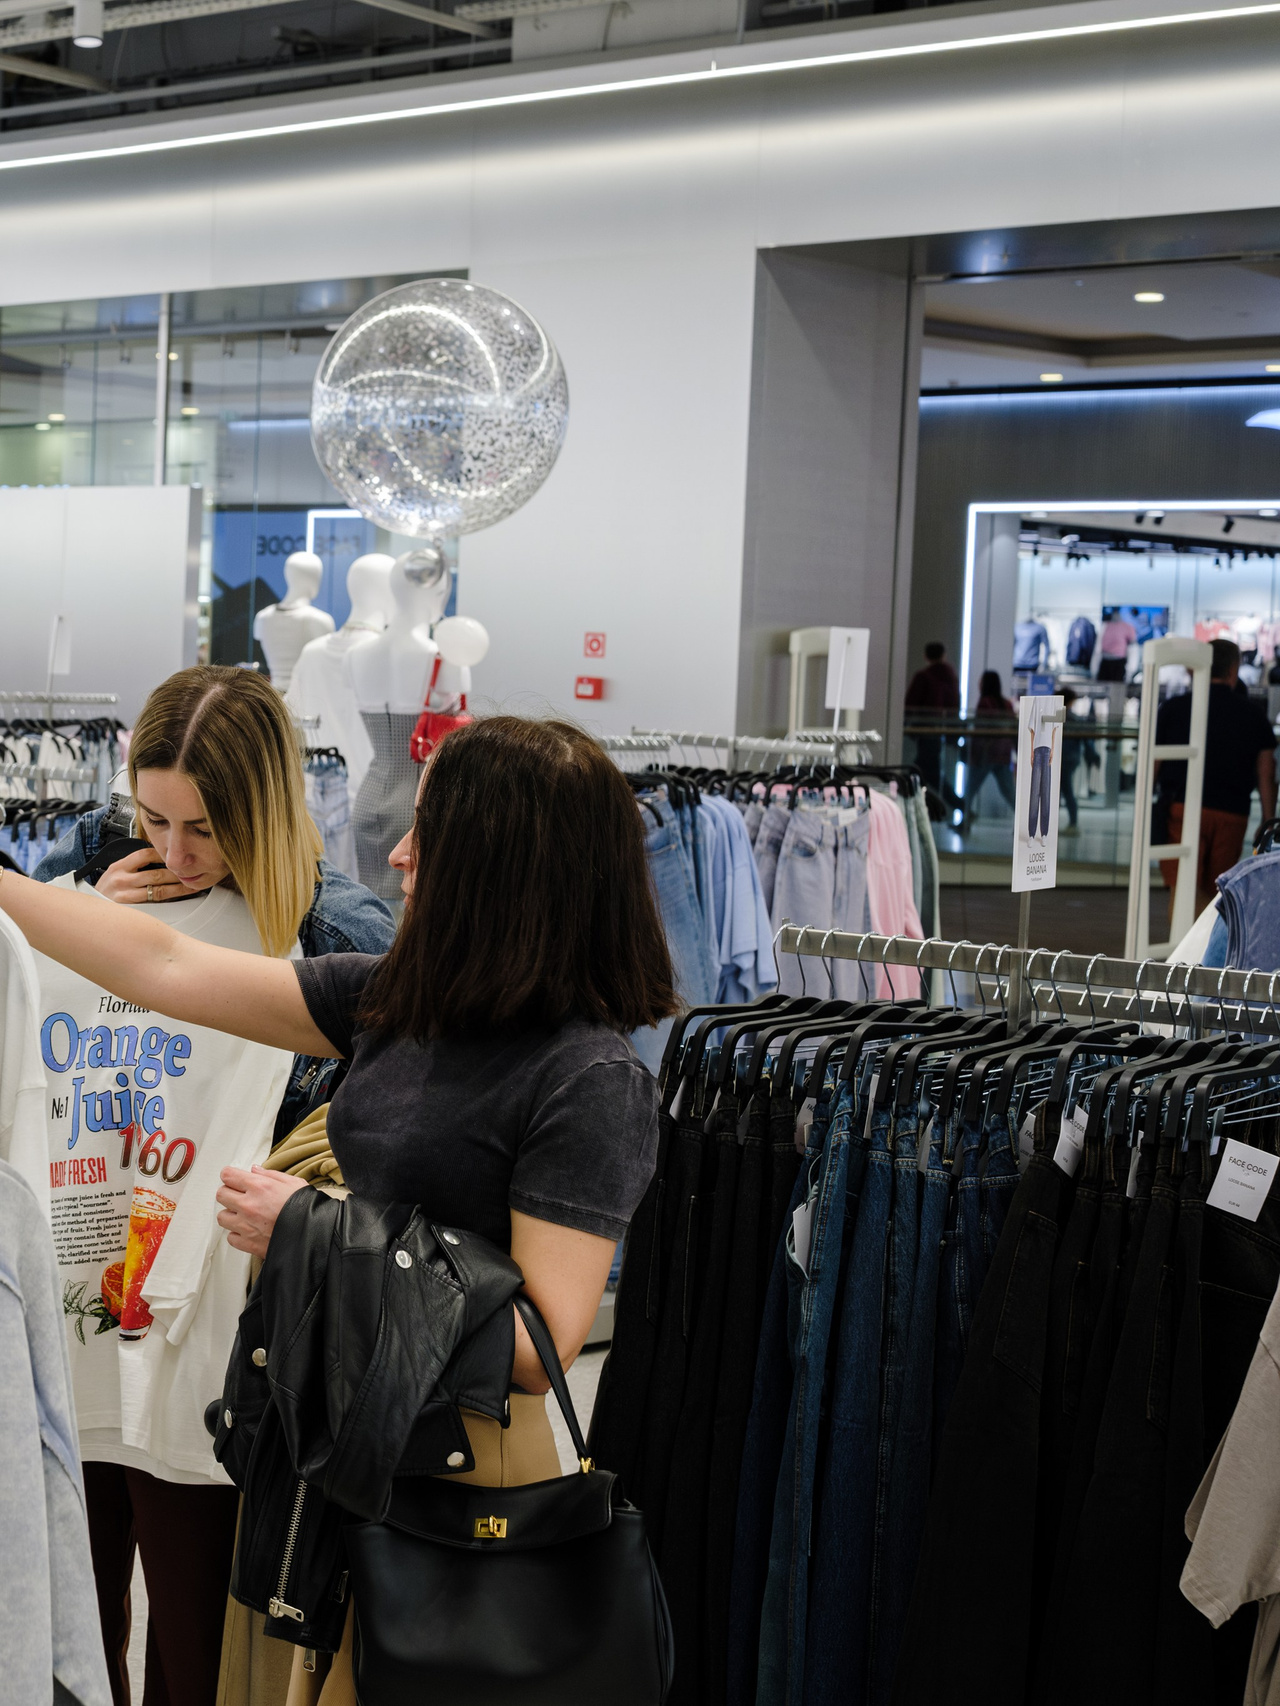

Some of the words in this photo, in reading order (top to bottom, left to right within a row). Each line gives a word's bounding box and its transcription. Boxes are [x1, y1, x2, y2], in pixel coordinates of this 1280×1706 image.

[1029, 852, 1045, 863] LOOSE
[1026, 865, 1047, 876] BANANA
[98, 995, 151, 1014] Flori
[40, 1012, 192, 1089] Orange
[68, 1156, 107, 1186] FRESH
[1228, 1156, 1246, 1168] FACE
[1247, 1163, 1268, 1176] CODE
[83, 1208, 115, 1216] consistency
[96, 1214, 129, 1224] preparation
[67, 1249, 90, 1257] clarified
[99, 1245, 127, 1253] unclarifie
[74, 1257, 90, 1265] added
